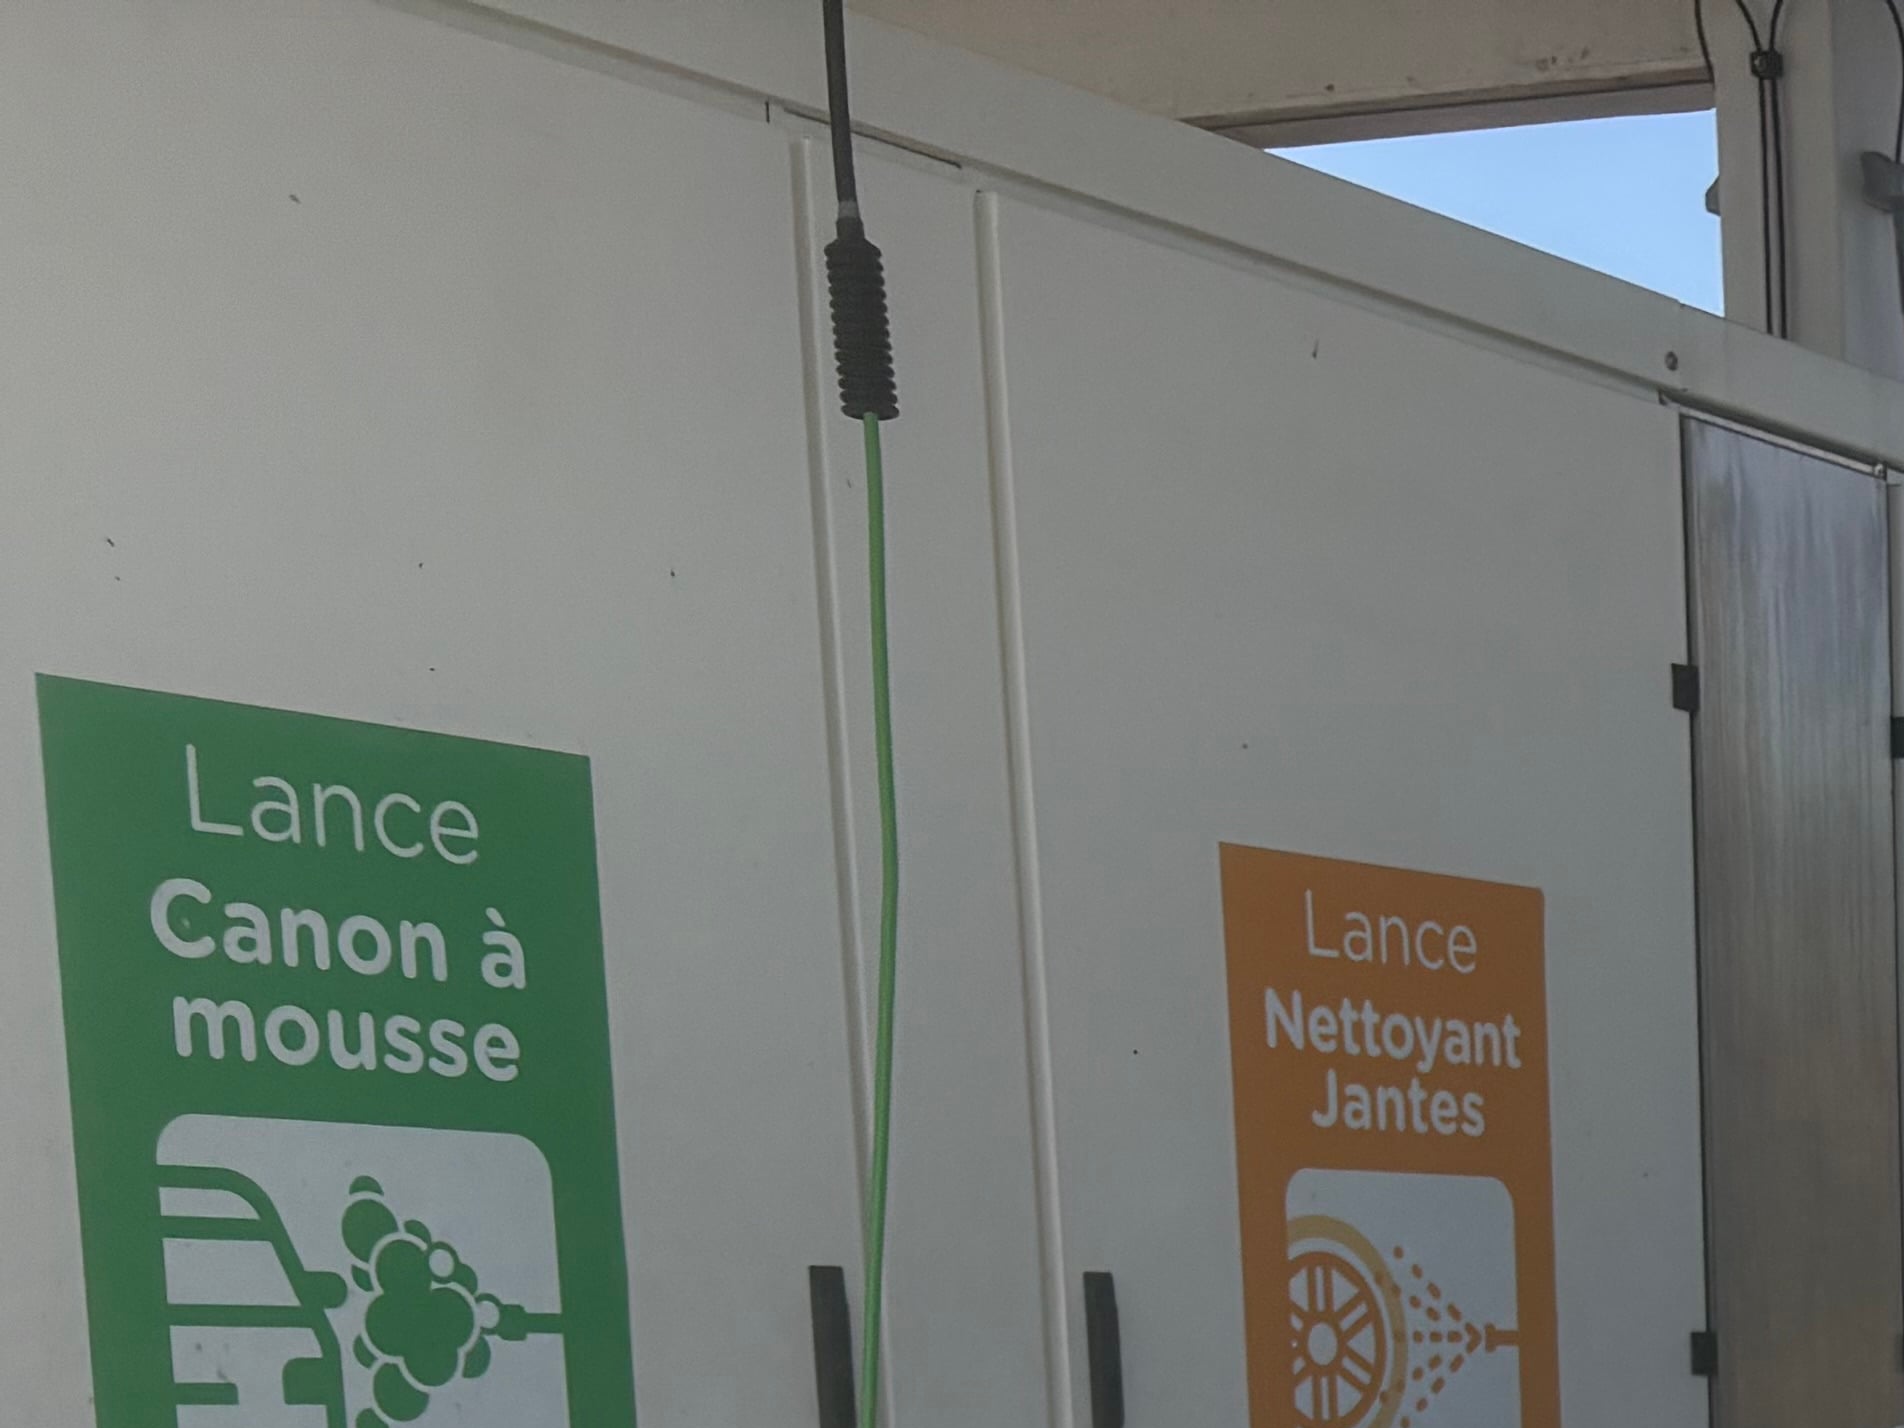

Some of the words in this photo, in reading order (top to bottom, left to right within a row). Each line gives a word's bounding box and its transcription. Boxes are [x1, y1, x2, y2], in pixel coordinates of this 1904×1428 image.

[183, 742, 481, 866] Lance
[149, 876, 449, 984] Canon
[479, 906, 528, 990] à
[1304, 888, 1478, 975] Lance
[172, 993, 521, 1083] mousse
[1263, 986, 1522, 1074] Nettoyant
[1311, 1068, 1486, 1138] Jantes
